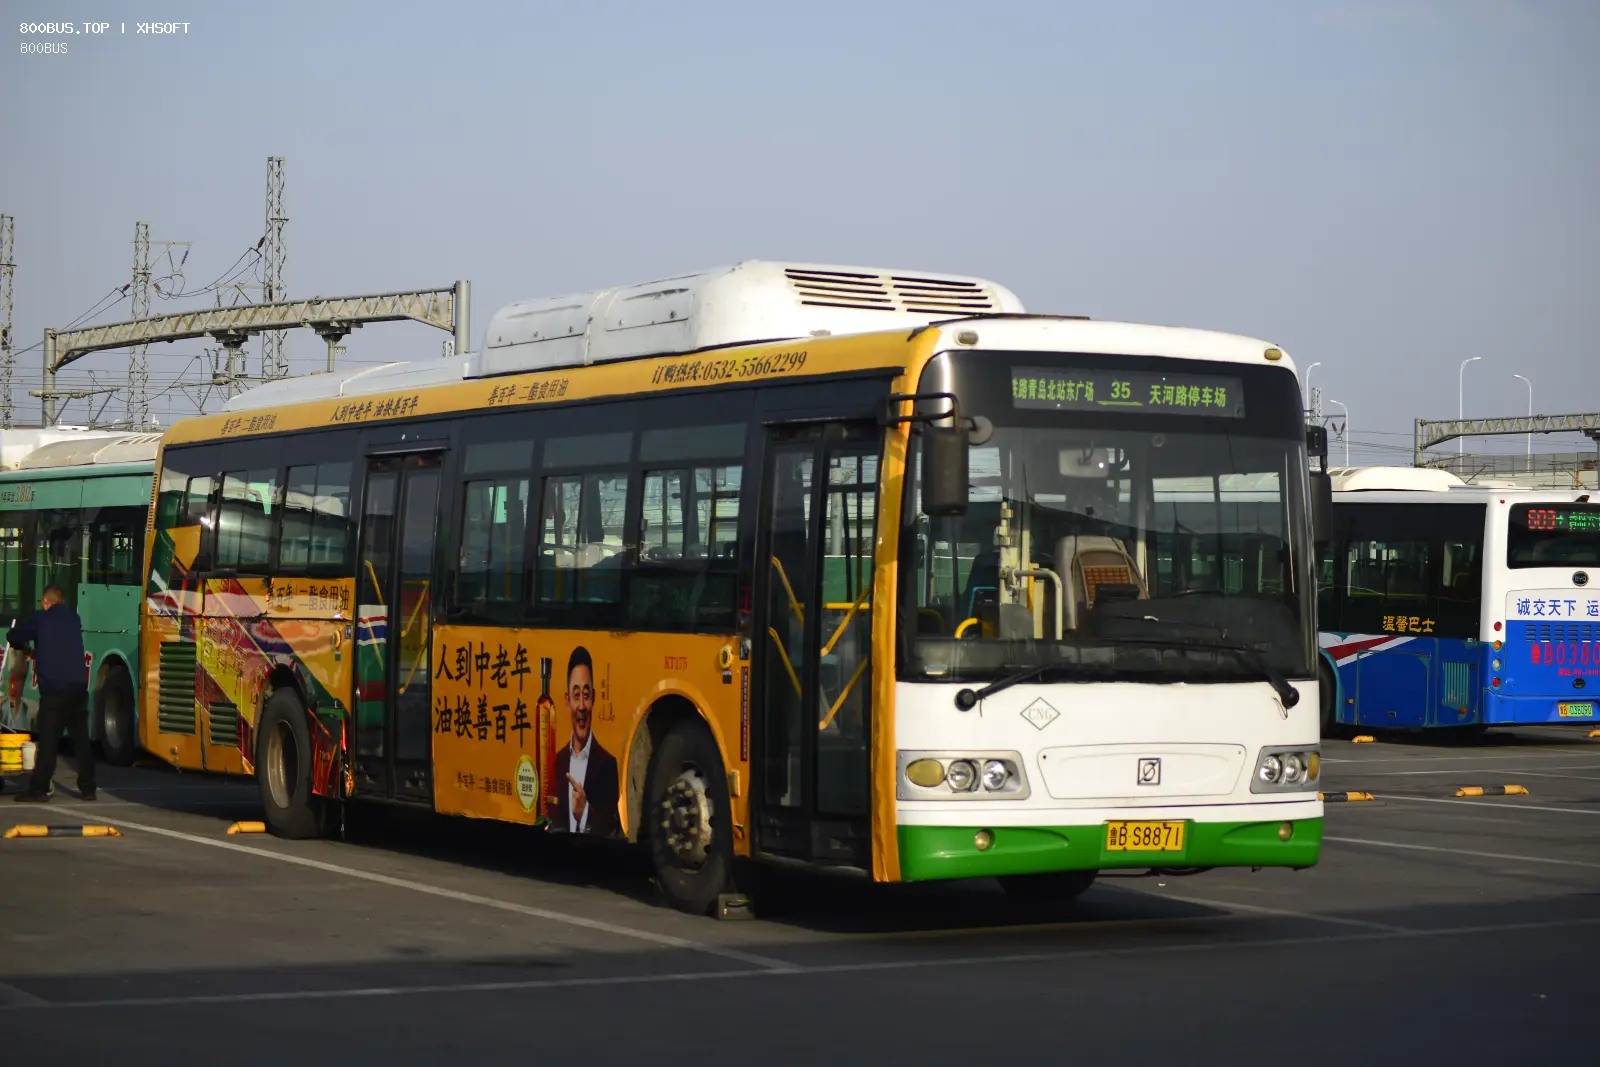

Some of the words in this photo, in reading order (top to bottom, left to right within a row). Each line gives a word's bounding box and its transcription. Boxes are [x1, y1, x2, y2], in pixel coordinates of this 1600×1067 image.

[1111, 381, 1131, 399] 35
[1149, 384, 1226, 408] 天河路停车场
[330, 400, 373, 422] 人到中老年
[373, 395, 420, 417] 油换善百年
[1516, 598, 1577, 617] 诚交天下
[1382, 615, 1436, 633] 温馨巴士
[434, 641, 532, 694] 人到中老年
[434, 695, 532, 748] 油换善百年
[1028, 707, 1054, 721] CNG
